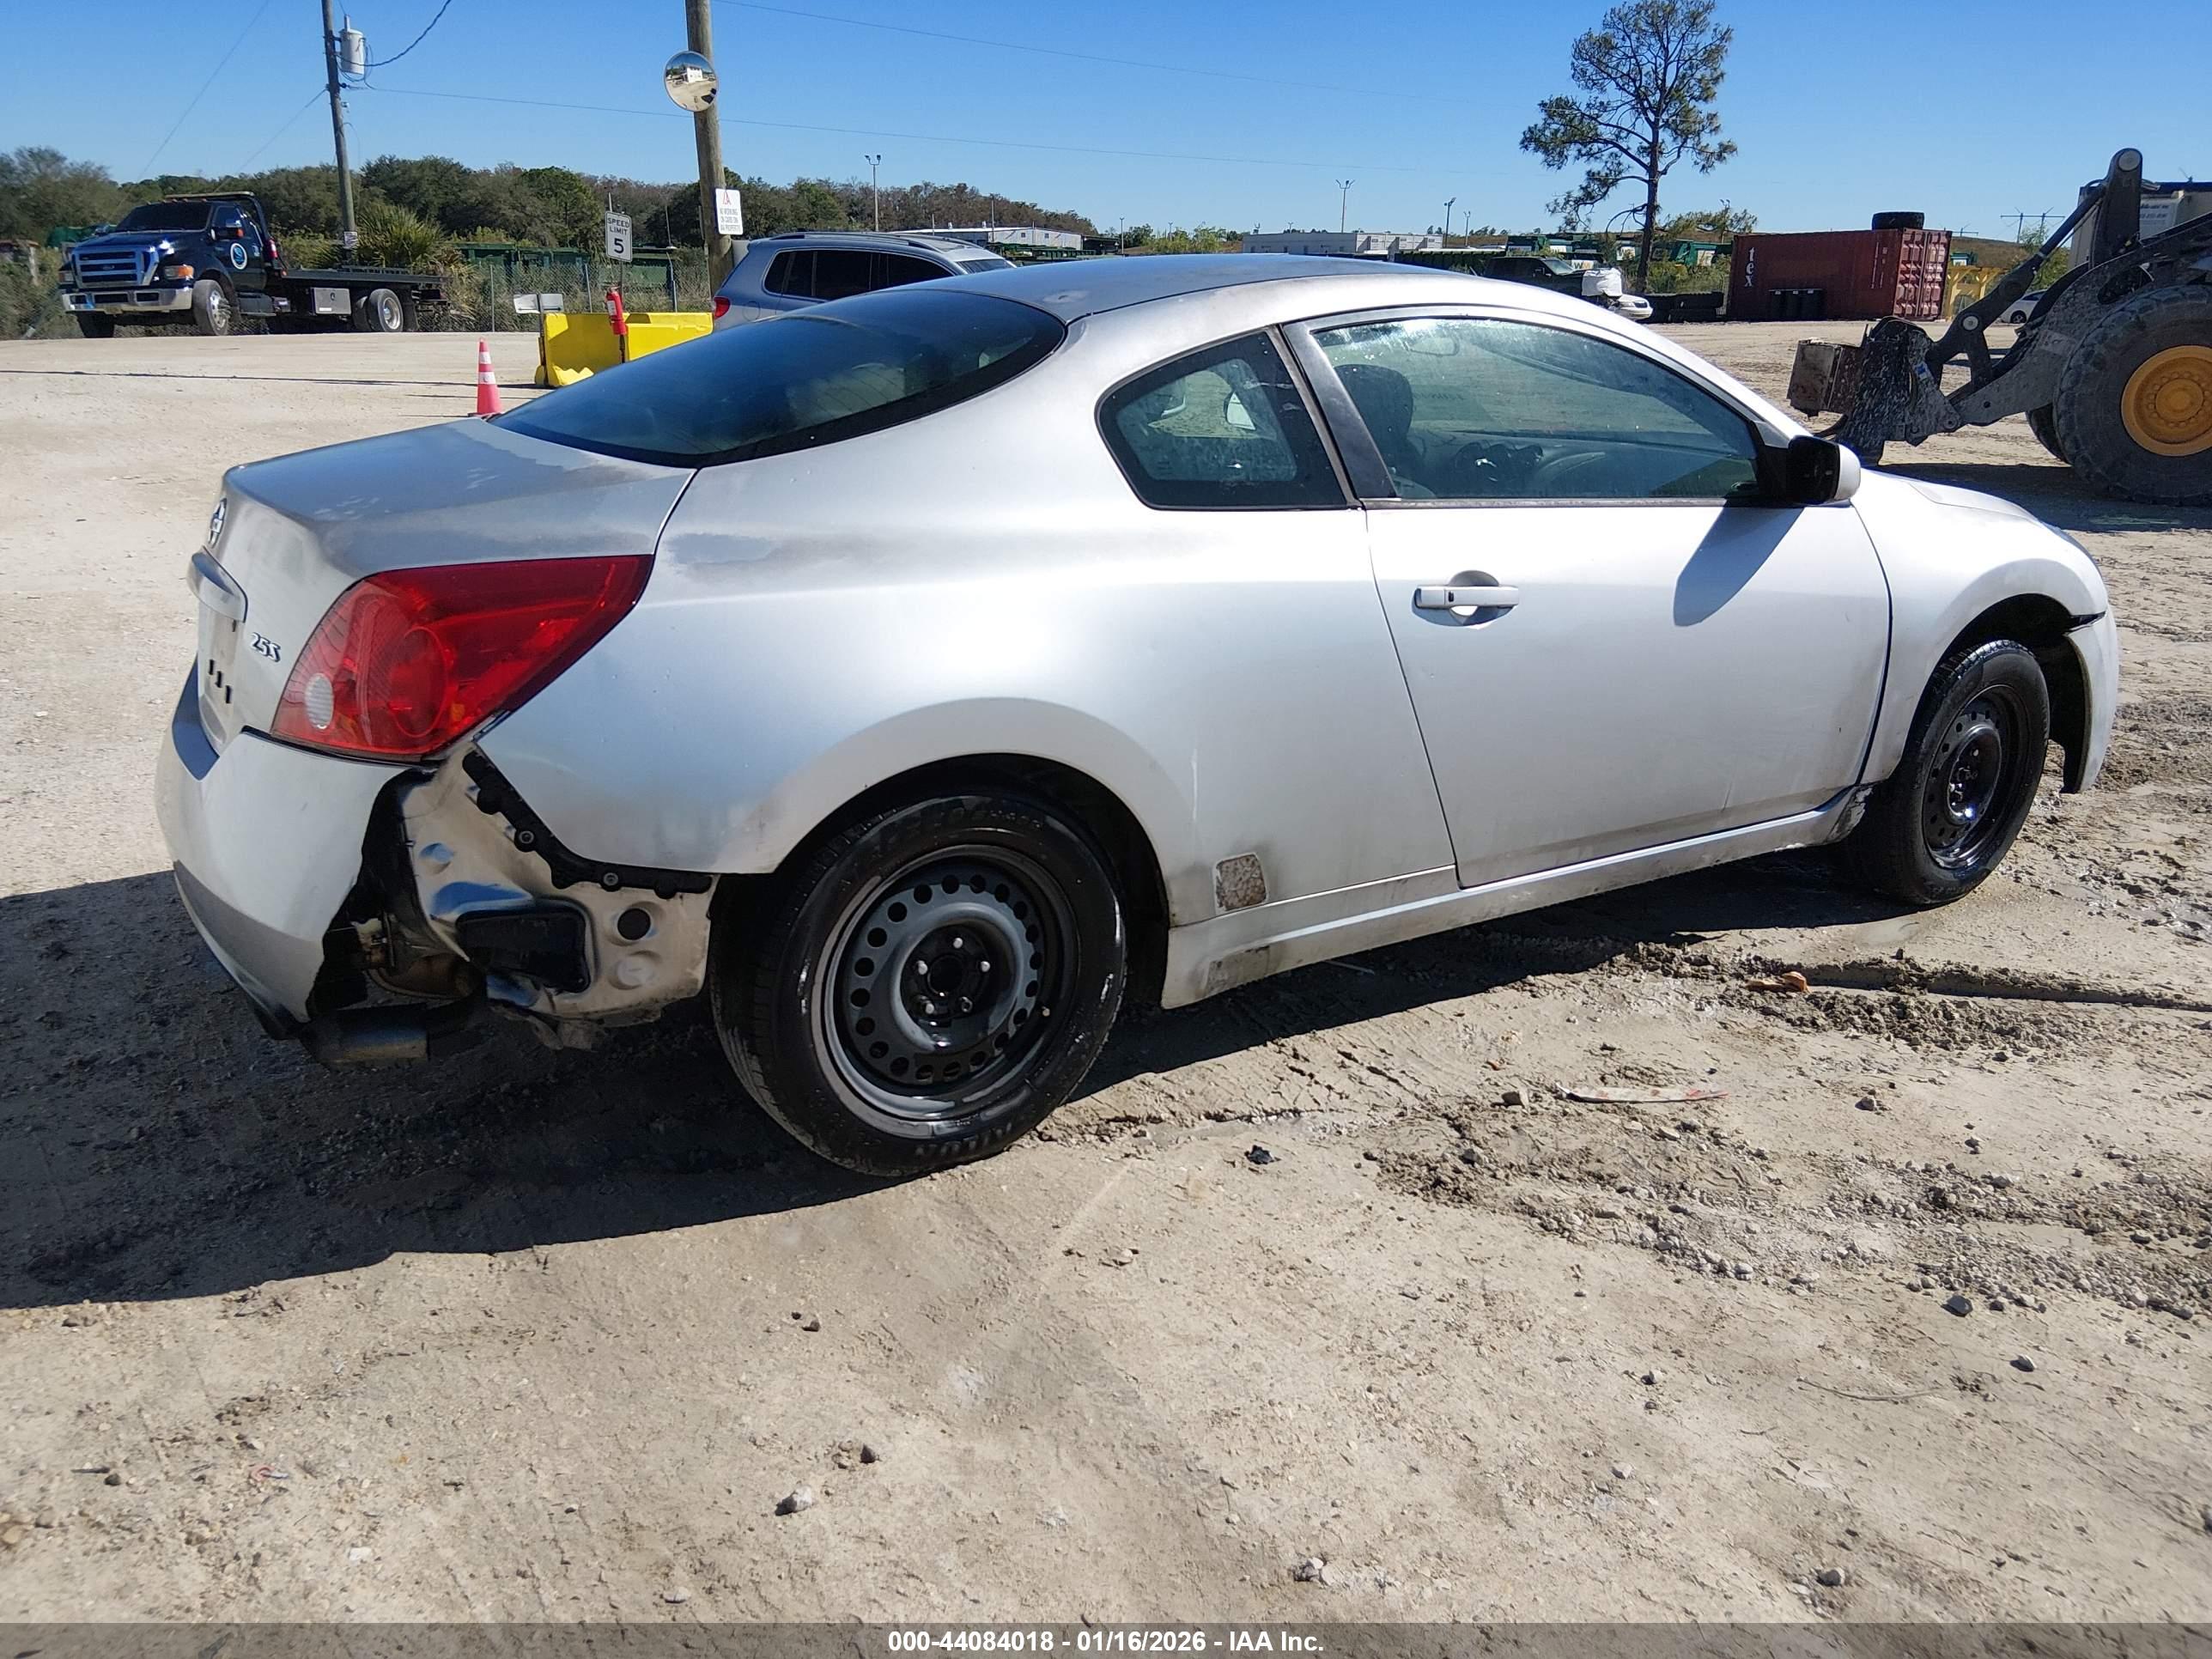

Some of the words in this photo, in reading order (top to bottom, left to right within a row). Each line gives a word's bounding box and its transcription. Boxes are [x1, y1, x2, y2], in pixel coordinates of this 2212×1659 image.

[607, 218, 629, 228] SPEED
[610, 227, 628, 235] LIMIT
[614, 238, 624, 253] 5
[1744, 247, 1755, 287] tex
